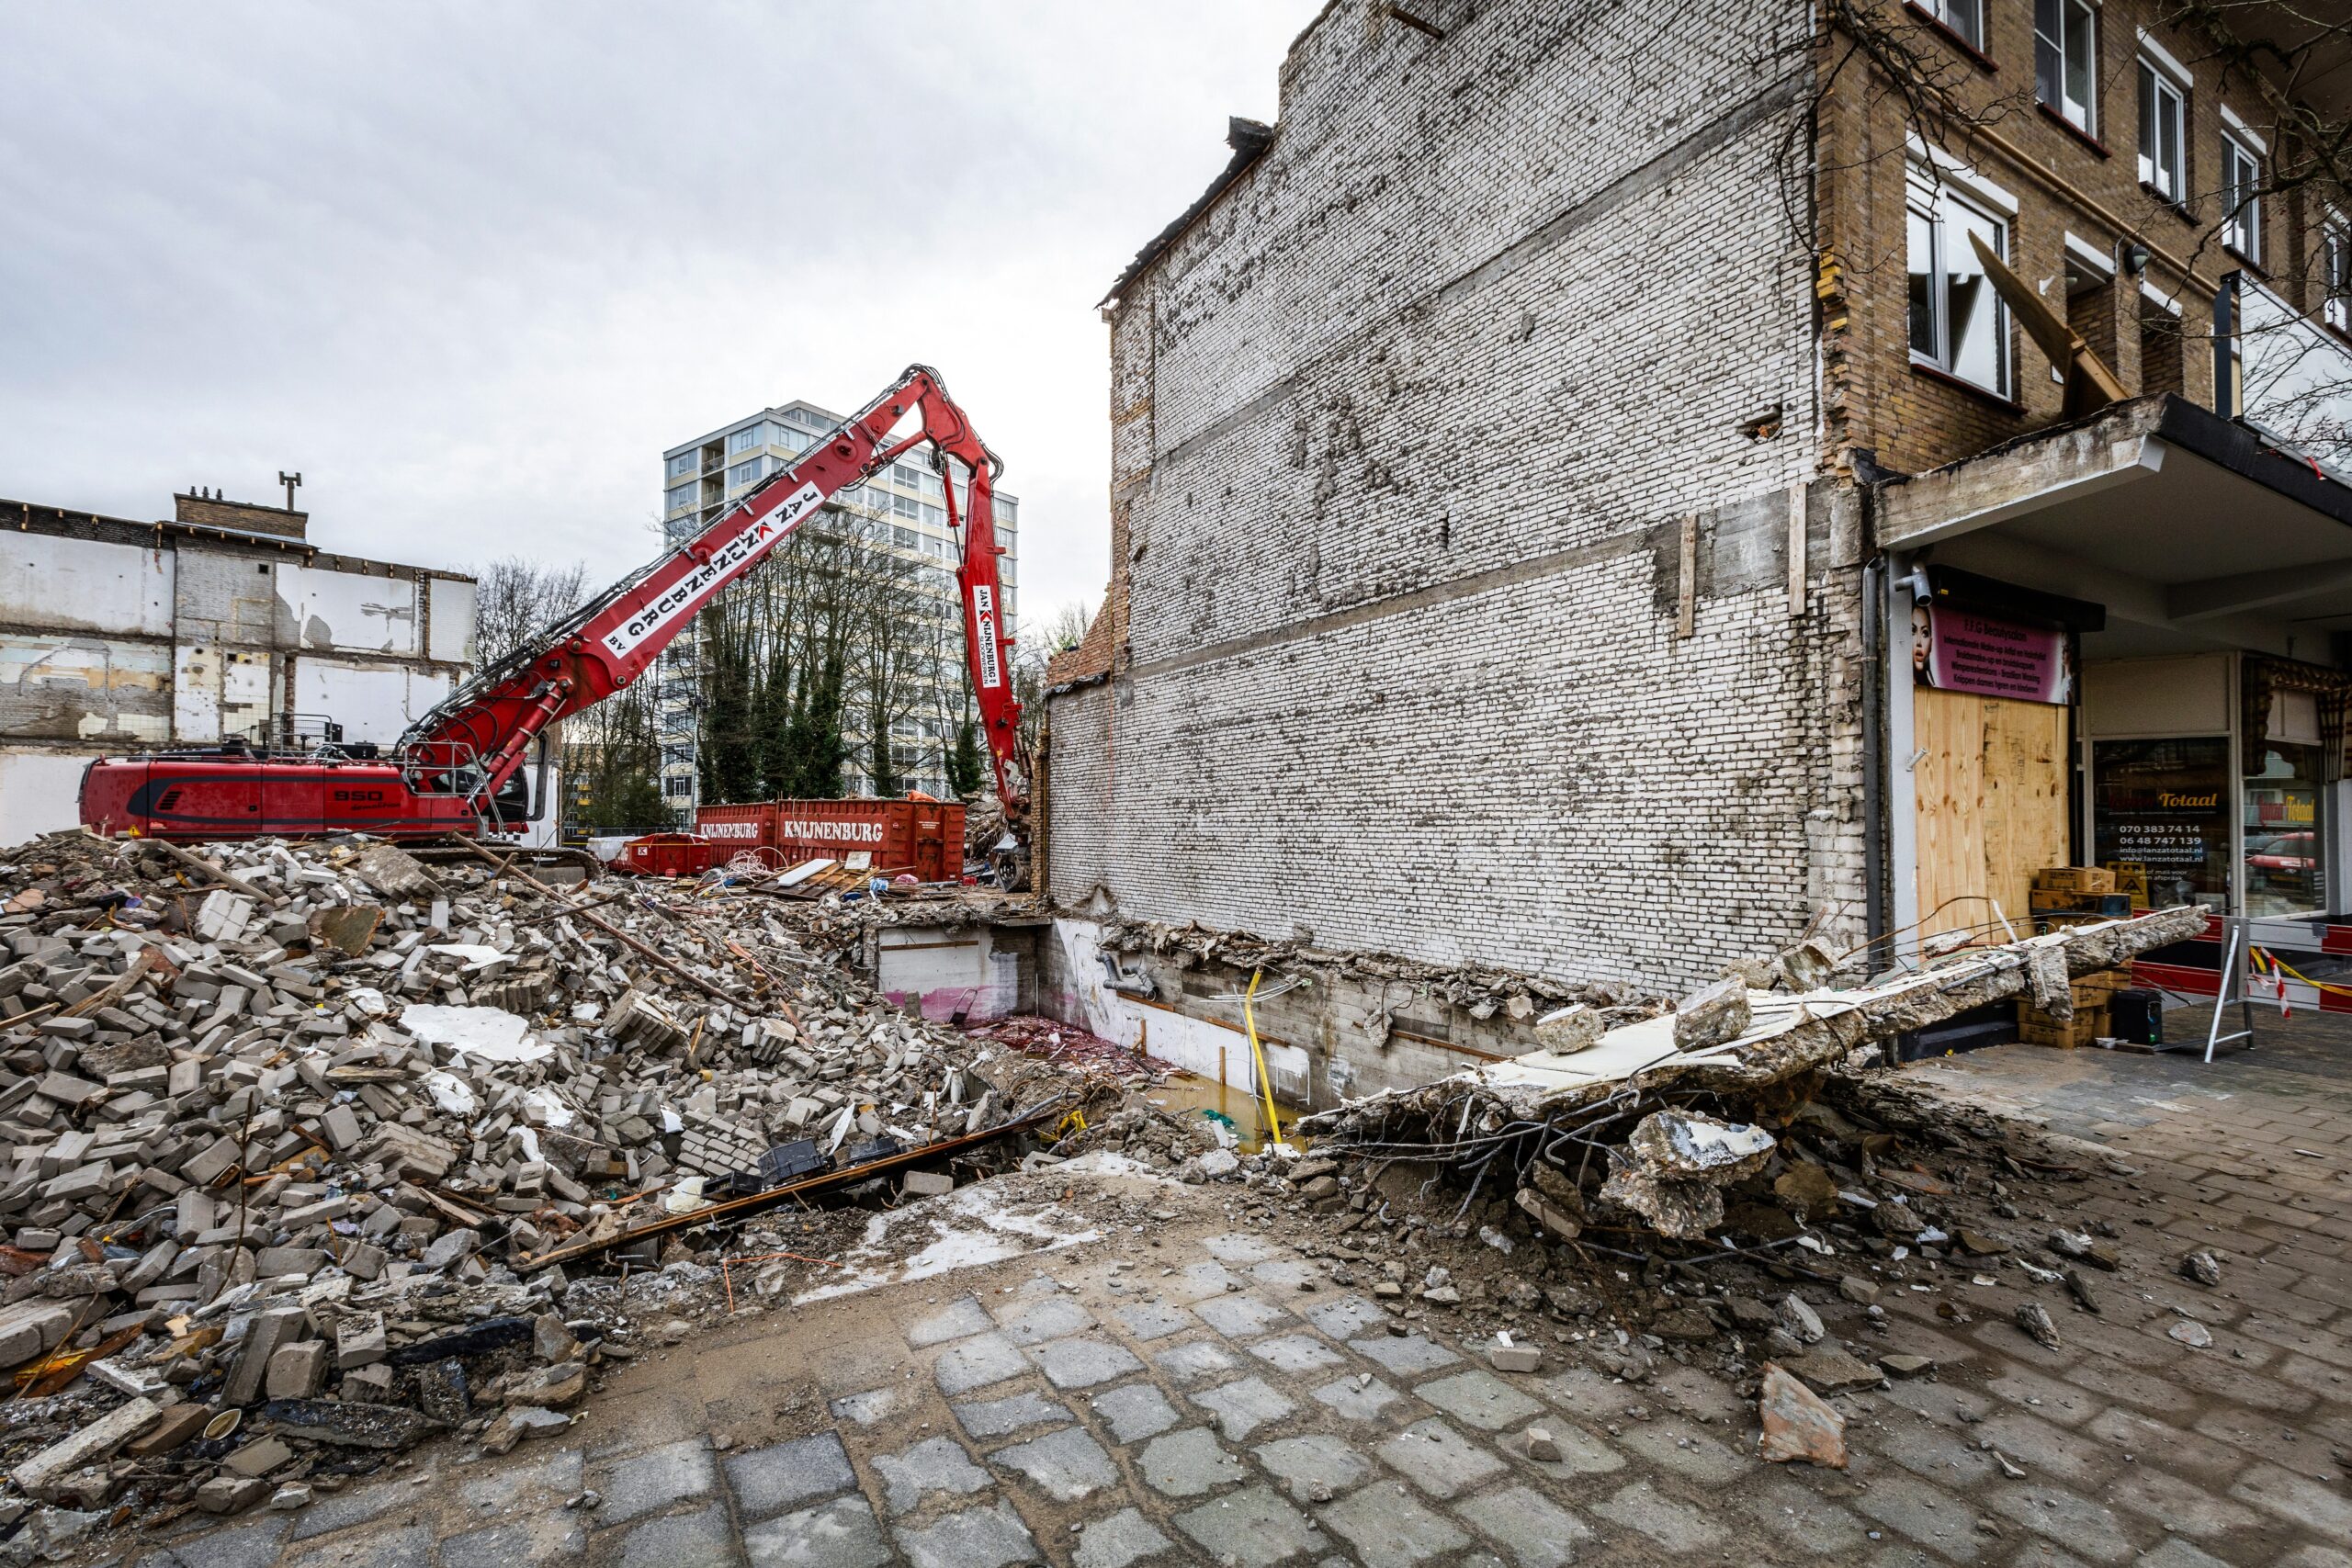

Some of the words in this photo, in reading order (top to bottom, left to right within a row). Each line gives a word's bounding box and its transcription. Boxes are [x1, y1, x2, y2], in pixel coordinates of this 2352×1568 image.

[775, 491, 818, 525] JAN
[979, 589, 989, 608] JAN
[1984, 624, 2028, 642] Beautysalon
[607, 635, 627, 651] BV
[978, 609, 996, 678] KNIJNENBURG
[334, 791, 382, 801] 950
[2158, 793, 2218, 807] Totaal
[700, 822, 759, 839] KNIJNENBURG
[784, 820, 884, 841] KNIJNENBURG
[2120, 825, 2141, 833] 070
[2143, 825, 2165, 833] 383
[2167, 825, 2183, 833] 74
[2186, 825, 2200, 833] 14
[2179, 837, 2202, 845] 139
